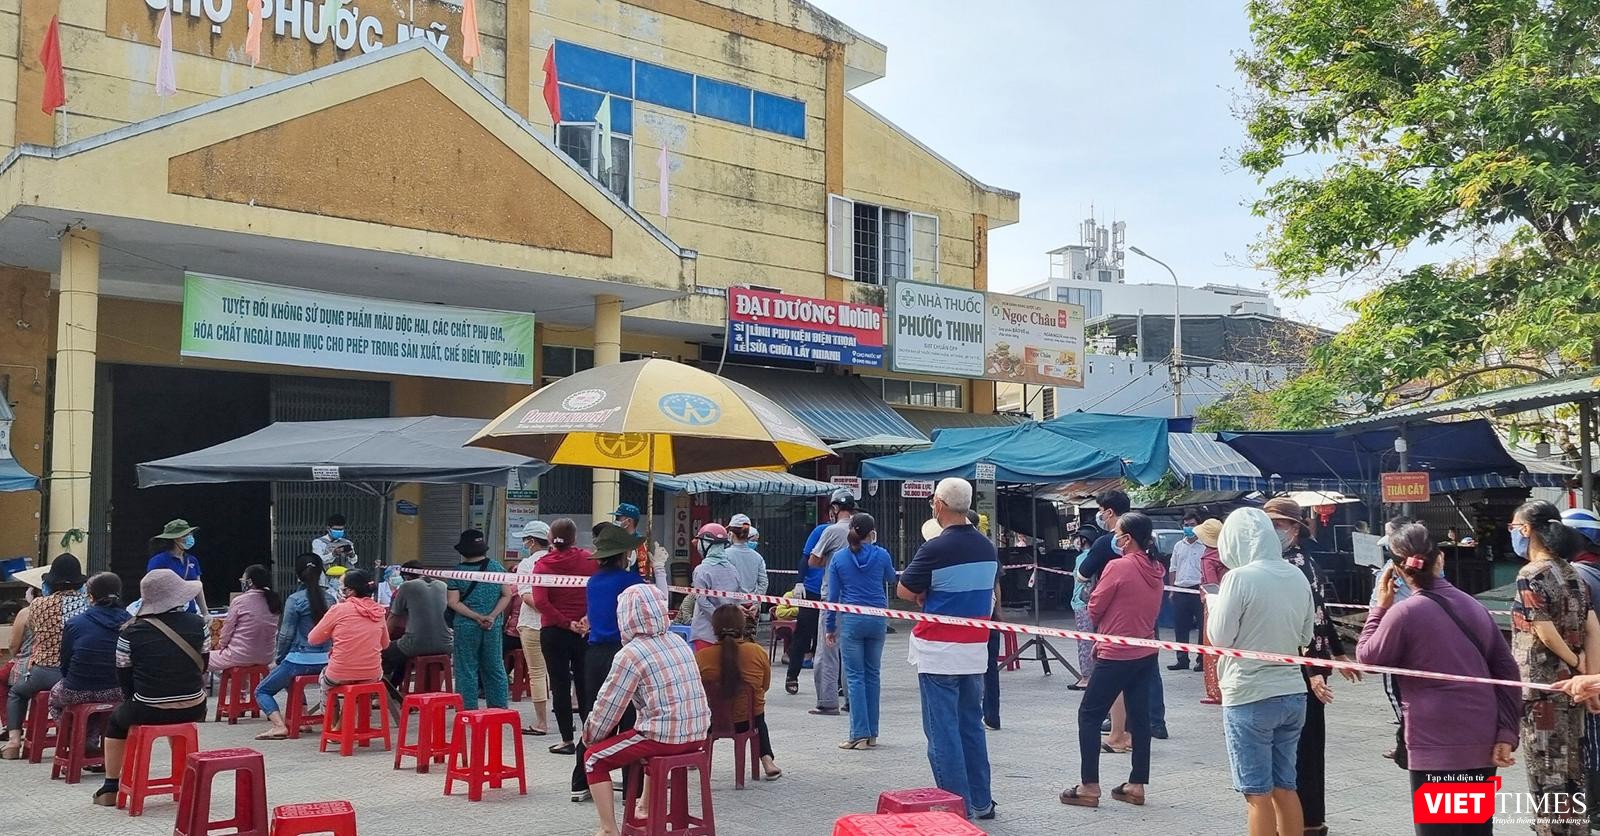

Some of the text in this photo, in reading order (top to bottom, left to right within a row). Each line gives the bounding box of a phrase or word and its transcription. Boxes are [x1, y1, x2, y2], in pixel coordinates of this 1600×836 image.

[736, 294, 880, 330] ĐẠI DƯƠNG Mobile
[918, 293, 980, 314] NHÀ THUỐC
[222, 296, 505, 342] TUYỆT ĐỐI KHÔNG SỬ DỤNG PHẨM MÀU ĐỘC HẠI, CÁC CHẤT PHỤ GIA,
[734, 321, 745, 332] SỈ
[1002, 308, 1027, 326] Ngọc
[1030, 312, 1056, 327] Châu
[734, 334, 744, 342] &
[772, 328, 790, 341] PHỤ
[790, 327, 810, 344] KIỆN
[812, 330, 832, 346] ĐIỆN
[832, 336, 856, 348] THOẠI
[898, 314, 982, 346] PHƯỚC THỊNH
[194, 320, 525, 369] HÓA CHẤT NGOÀI DANH MỤC CHO PHÉP TRONG SẢN XUẤT, CHẾ BIẾN THỰC PHẨM
[734, 341, 746, 352] LẺ
[750, 339, 768, 354] SỬA
[771, 342, 792, 356] CHỮA
[794, 344, 810, 358] LẤY
[811, 348, 840, 362] NHANH
[1408, 482, 1424, 495] CÂY
[678, 510, 687, 546] GẠO
